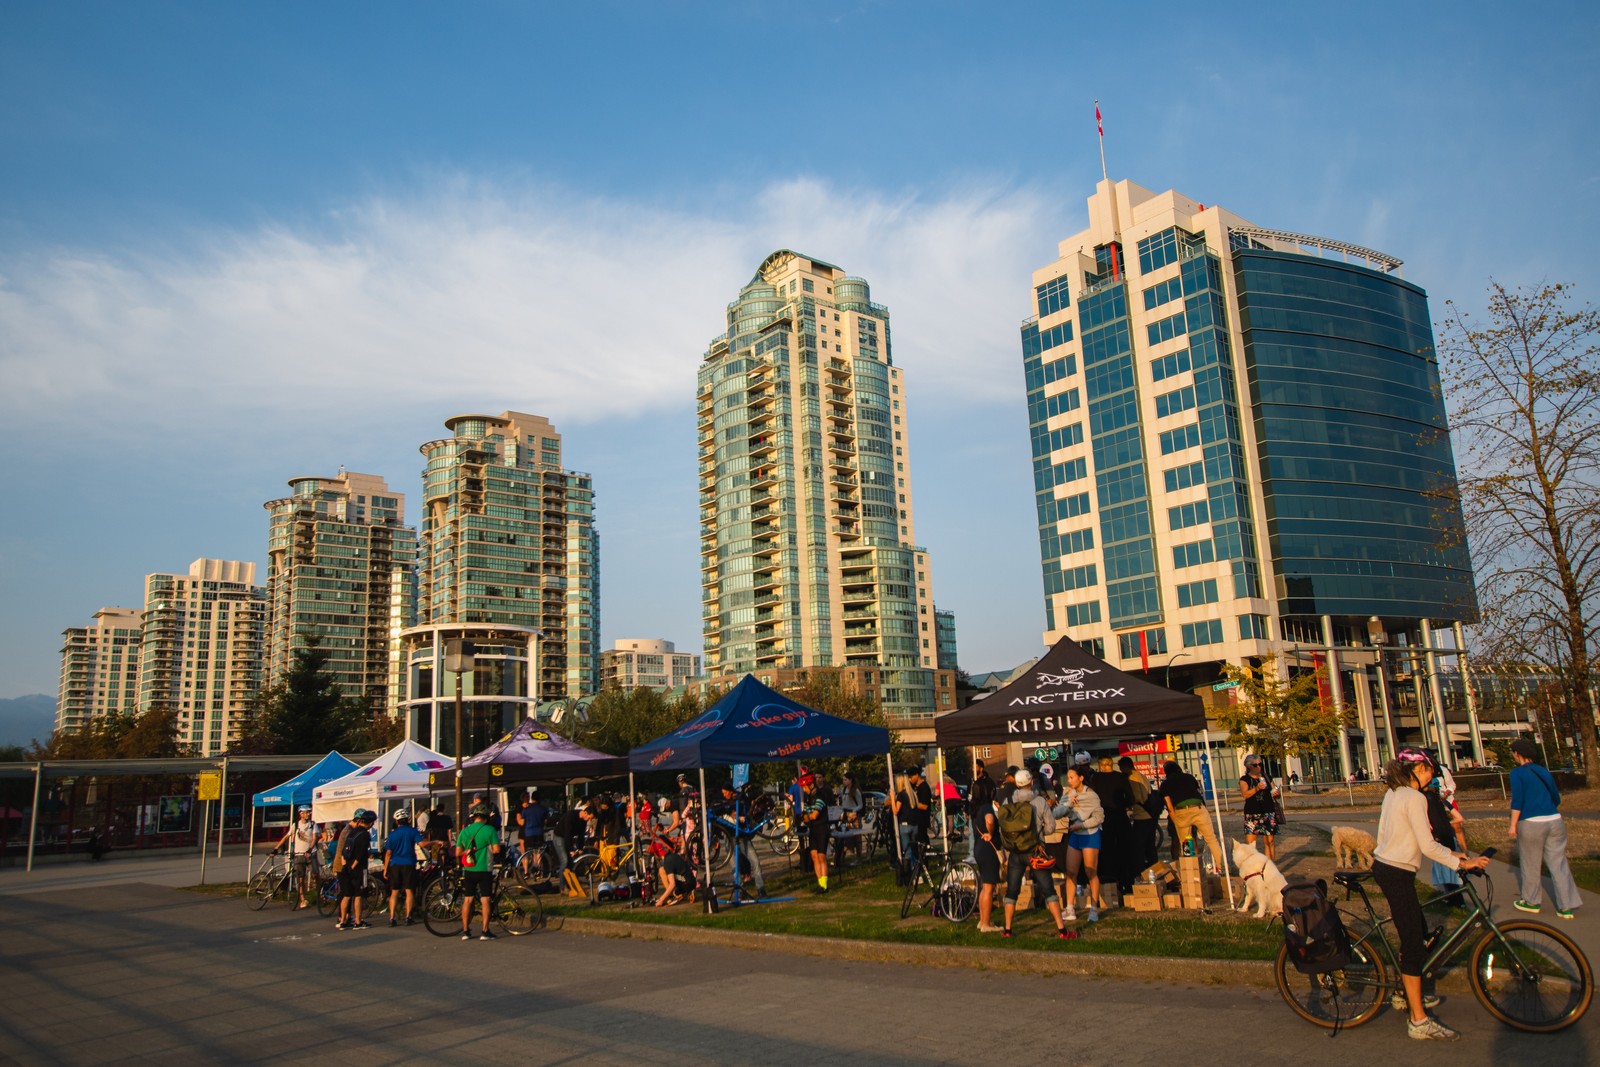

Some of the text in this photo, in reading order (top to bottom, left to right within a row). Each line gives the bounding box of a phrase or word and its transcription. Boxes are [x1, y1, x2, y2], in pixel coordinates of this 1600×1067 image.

[1009, 687, 1125, 706] ARC'TERYX
[748, 715, 781, 728] bike
[782, 710, 808, 721] guy
[1008, 711, 1127, 733] KITSILANO
[777, 743, 802, 757] bike
[803, 736, 822, 750] guy
[1127, 742, 1158, 752] Vancity
